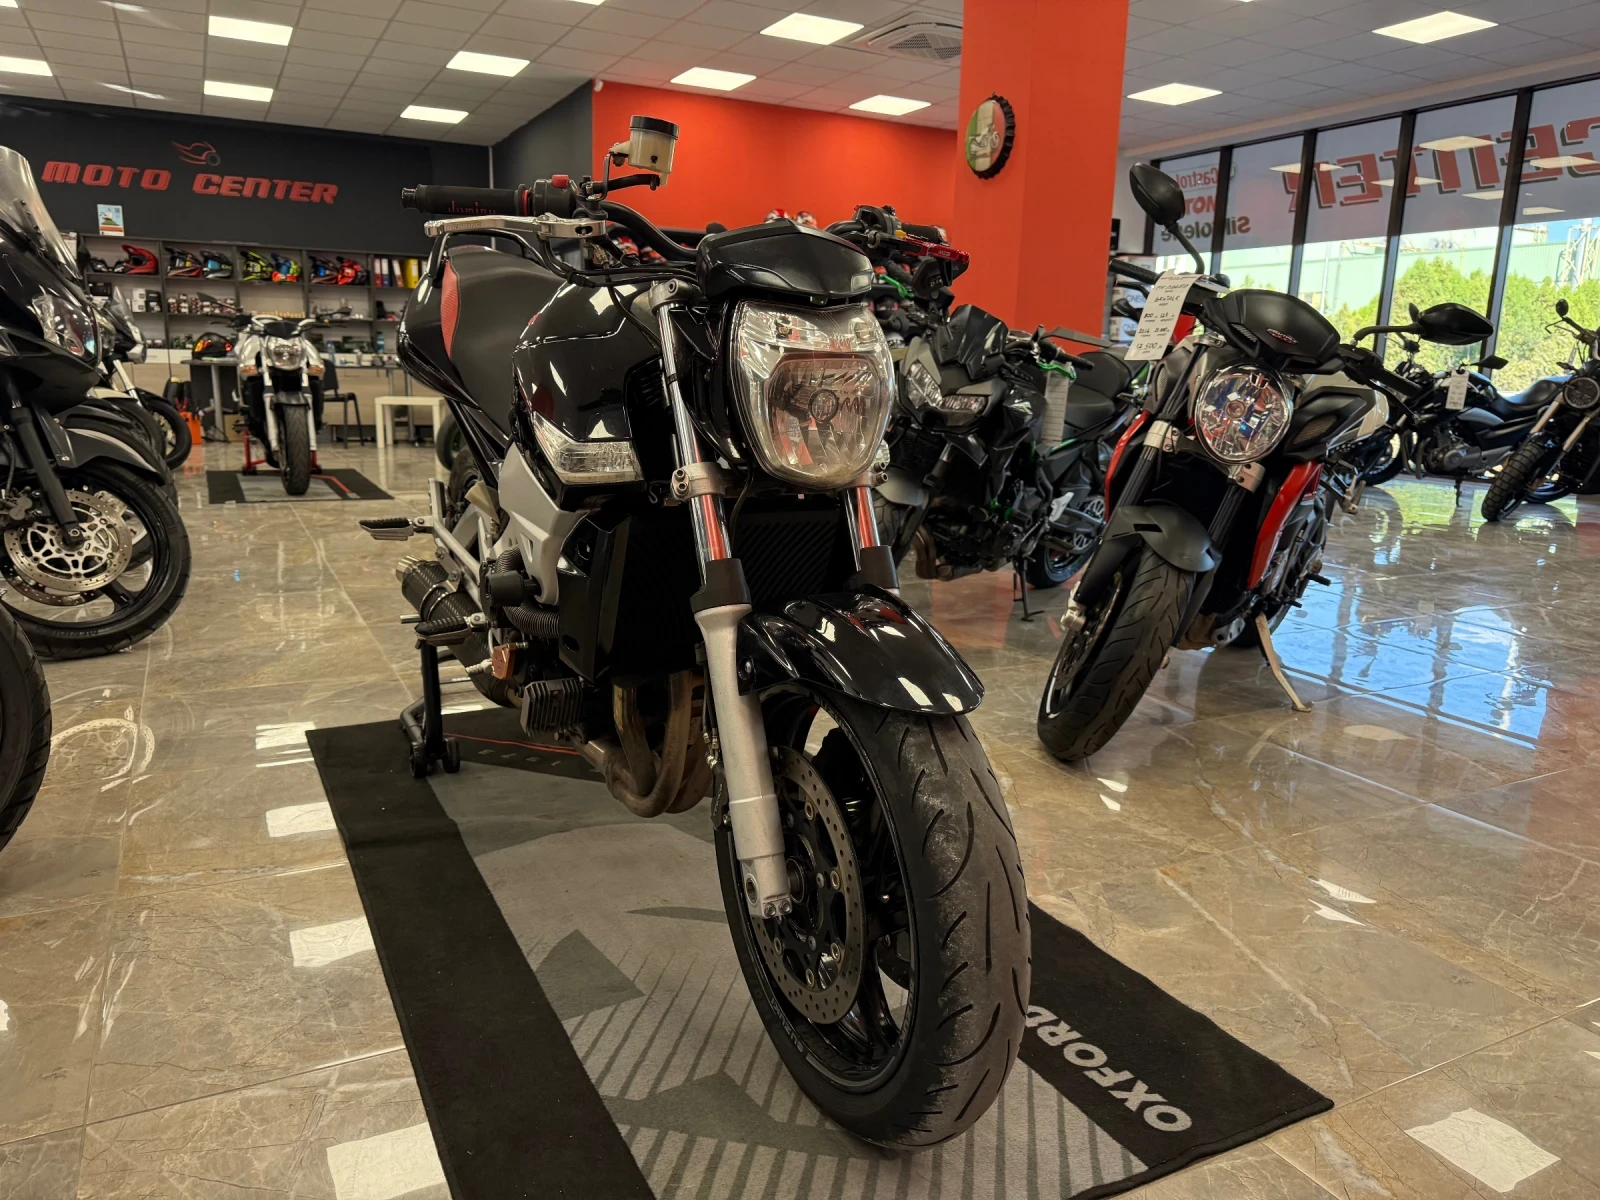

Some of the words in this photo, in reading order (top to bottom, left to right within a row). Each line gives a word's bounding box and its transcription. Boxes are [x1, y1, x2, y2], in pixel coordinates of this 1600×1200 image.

[41, 161, 171, 191] MOTO
[192, 173, 338, 205] CENTER
[1025, 1004, 1192, 1132] OXFORD
